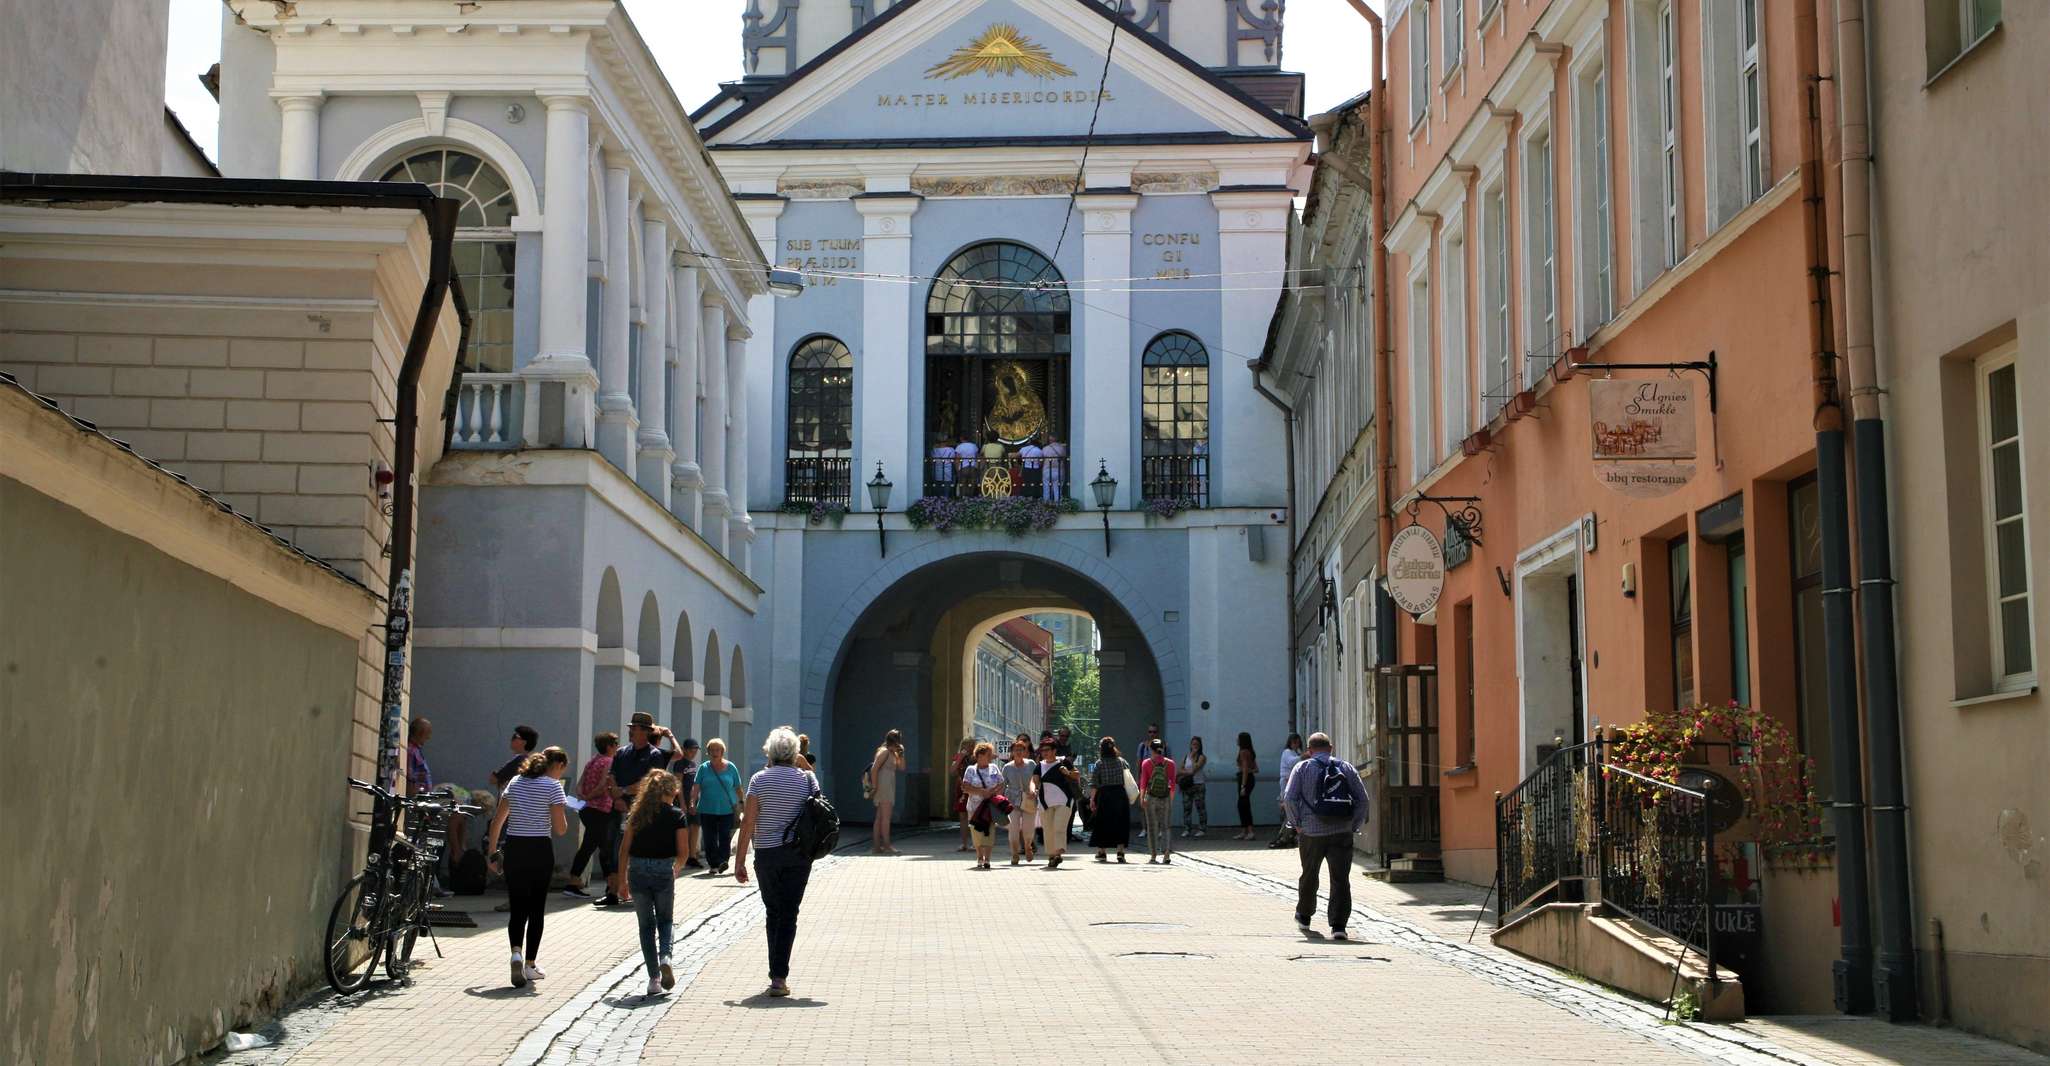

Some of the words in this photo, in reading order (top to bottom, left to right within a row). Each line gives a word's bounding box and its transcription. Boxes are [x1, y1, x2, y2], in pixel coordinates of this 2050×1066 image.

[877, 94, 949, 107] MATER
[786, 239, 812, 251] SUB
[817, 239, 862, 251] TUUM
[1142, 233, 1200, 246] CONFU
[1162, 249, 1183, 262] GI
[1638, 383, 1687, 404] Ugnies
[1607, 472, 1629, 486] bbq
[1631, 473, 1688, 485] restoranas
[1392, 585, 1440, 612] LOMBARDAS
